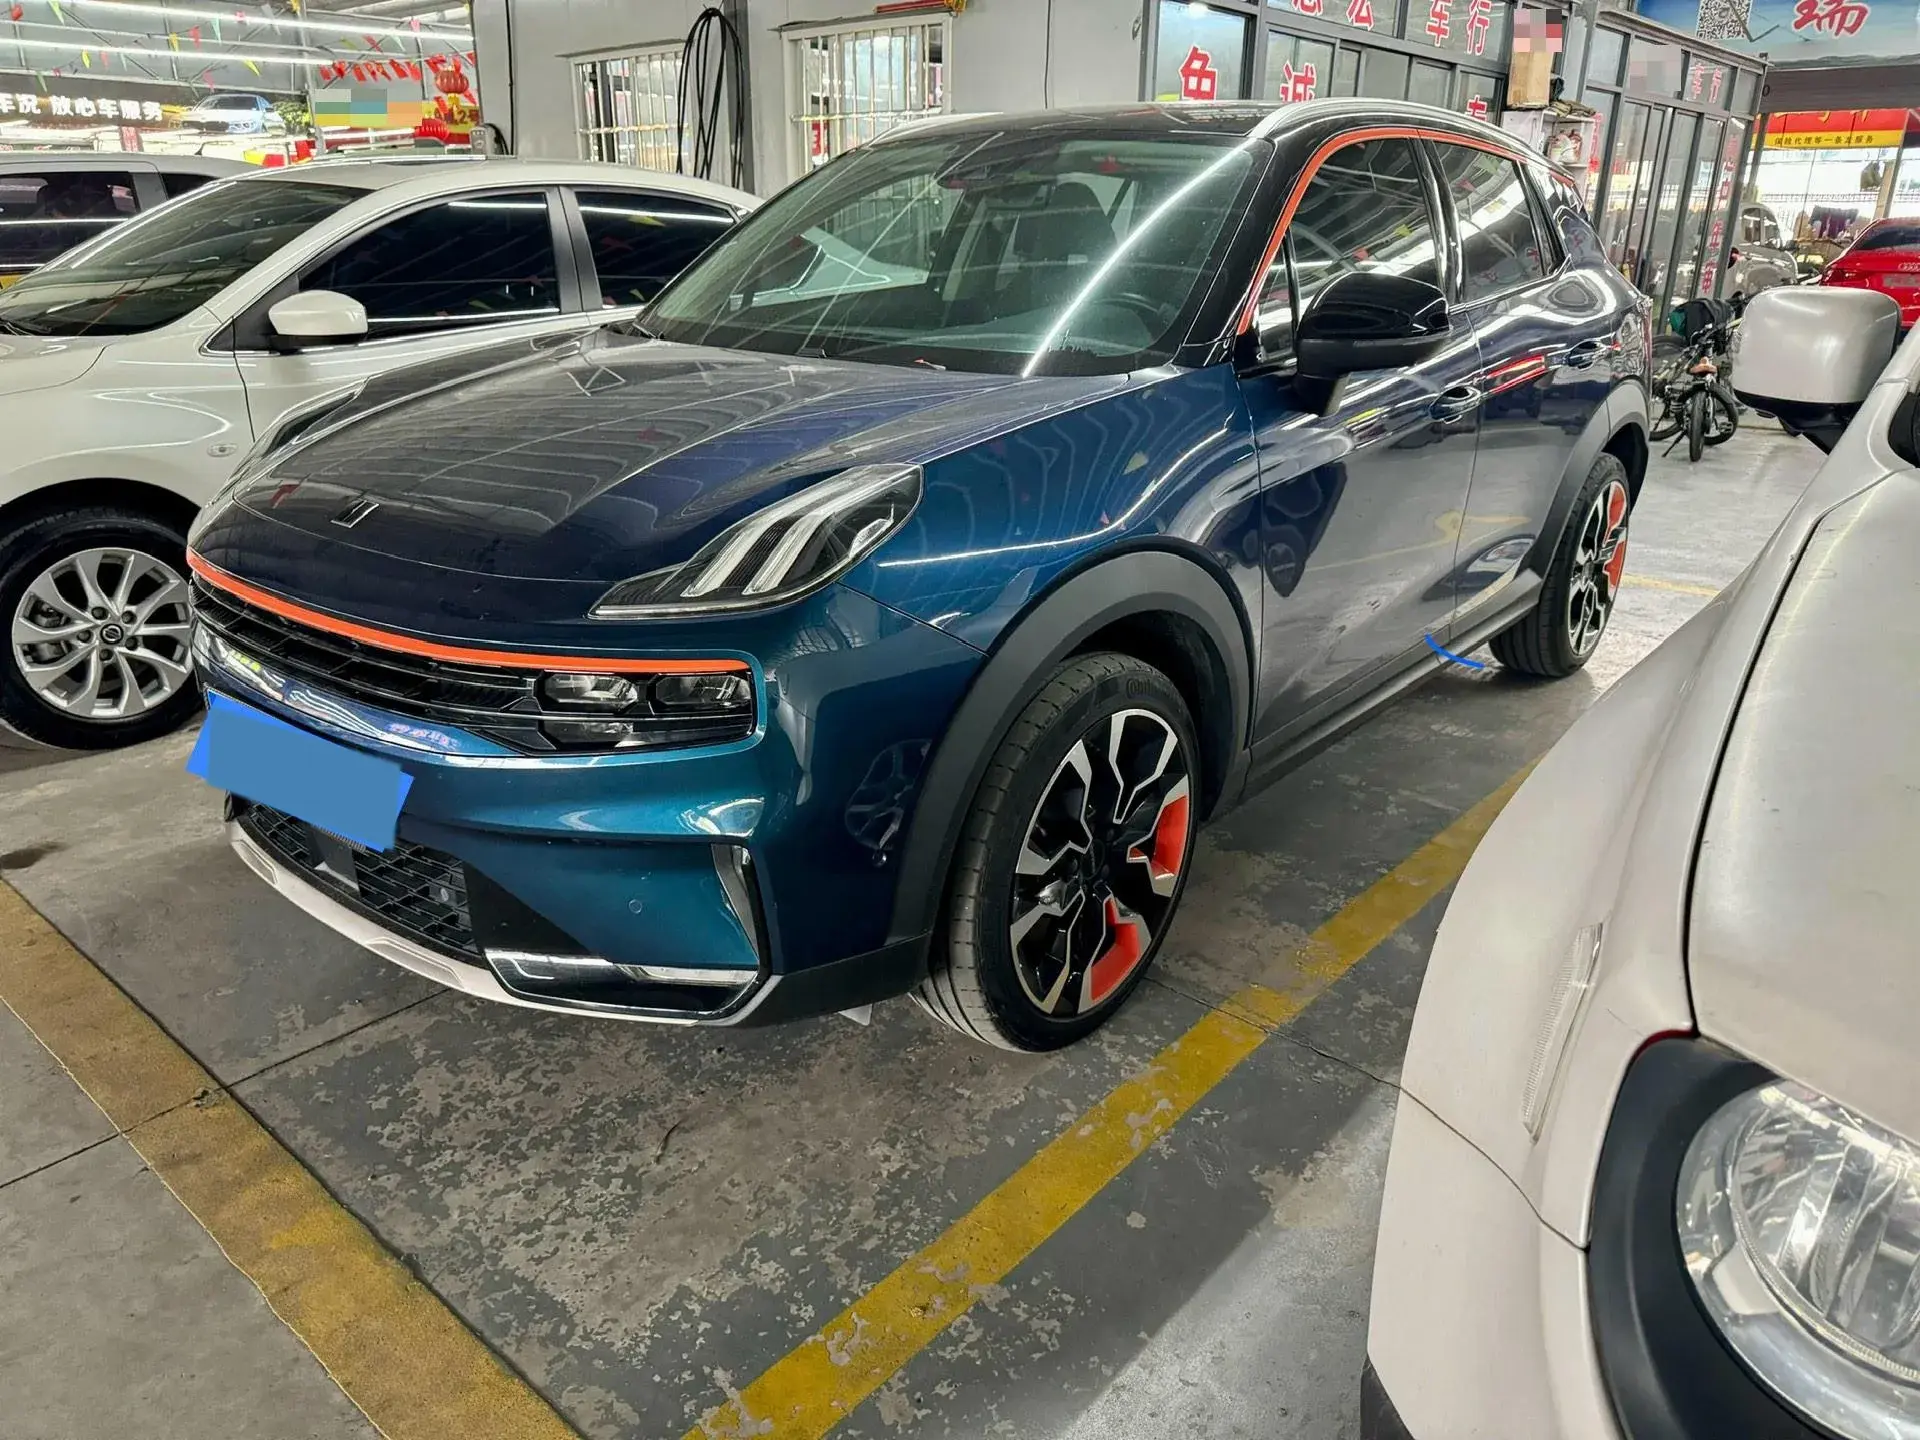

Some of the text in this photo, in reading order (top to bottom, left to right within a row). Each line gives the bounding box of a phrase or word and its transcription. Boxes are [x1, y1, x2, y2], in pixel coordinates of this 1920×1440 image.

[1792, 0, 1870, 38] 瑞
[50, 95, 163, 121] 放心车服务
